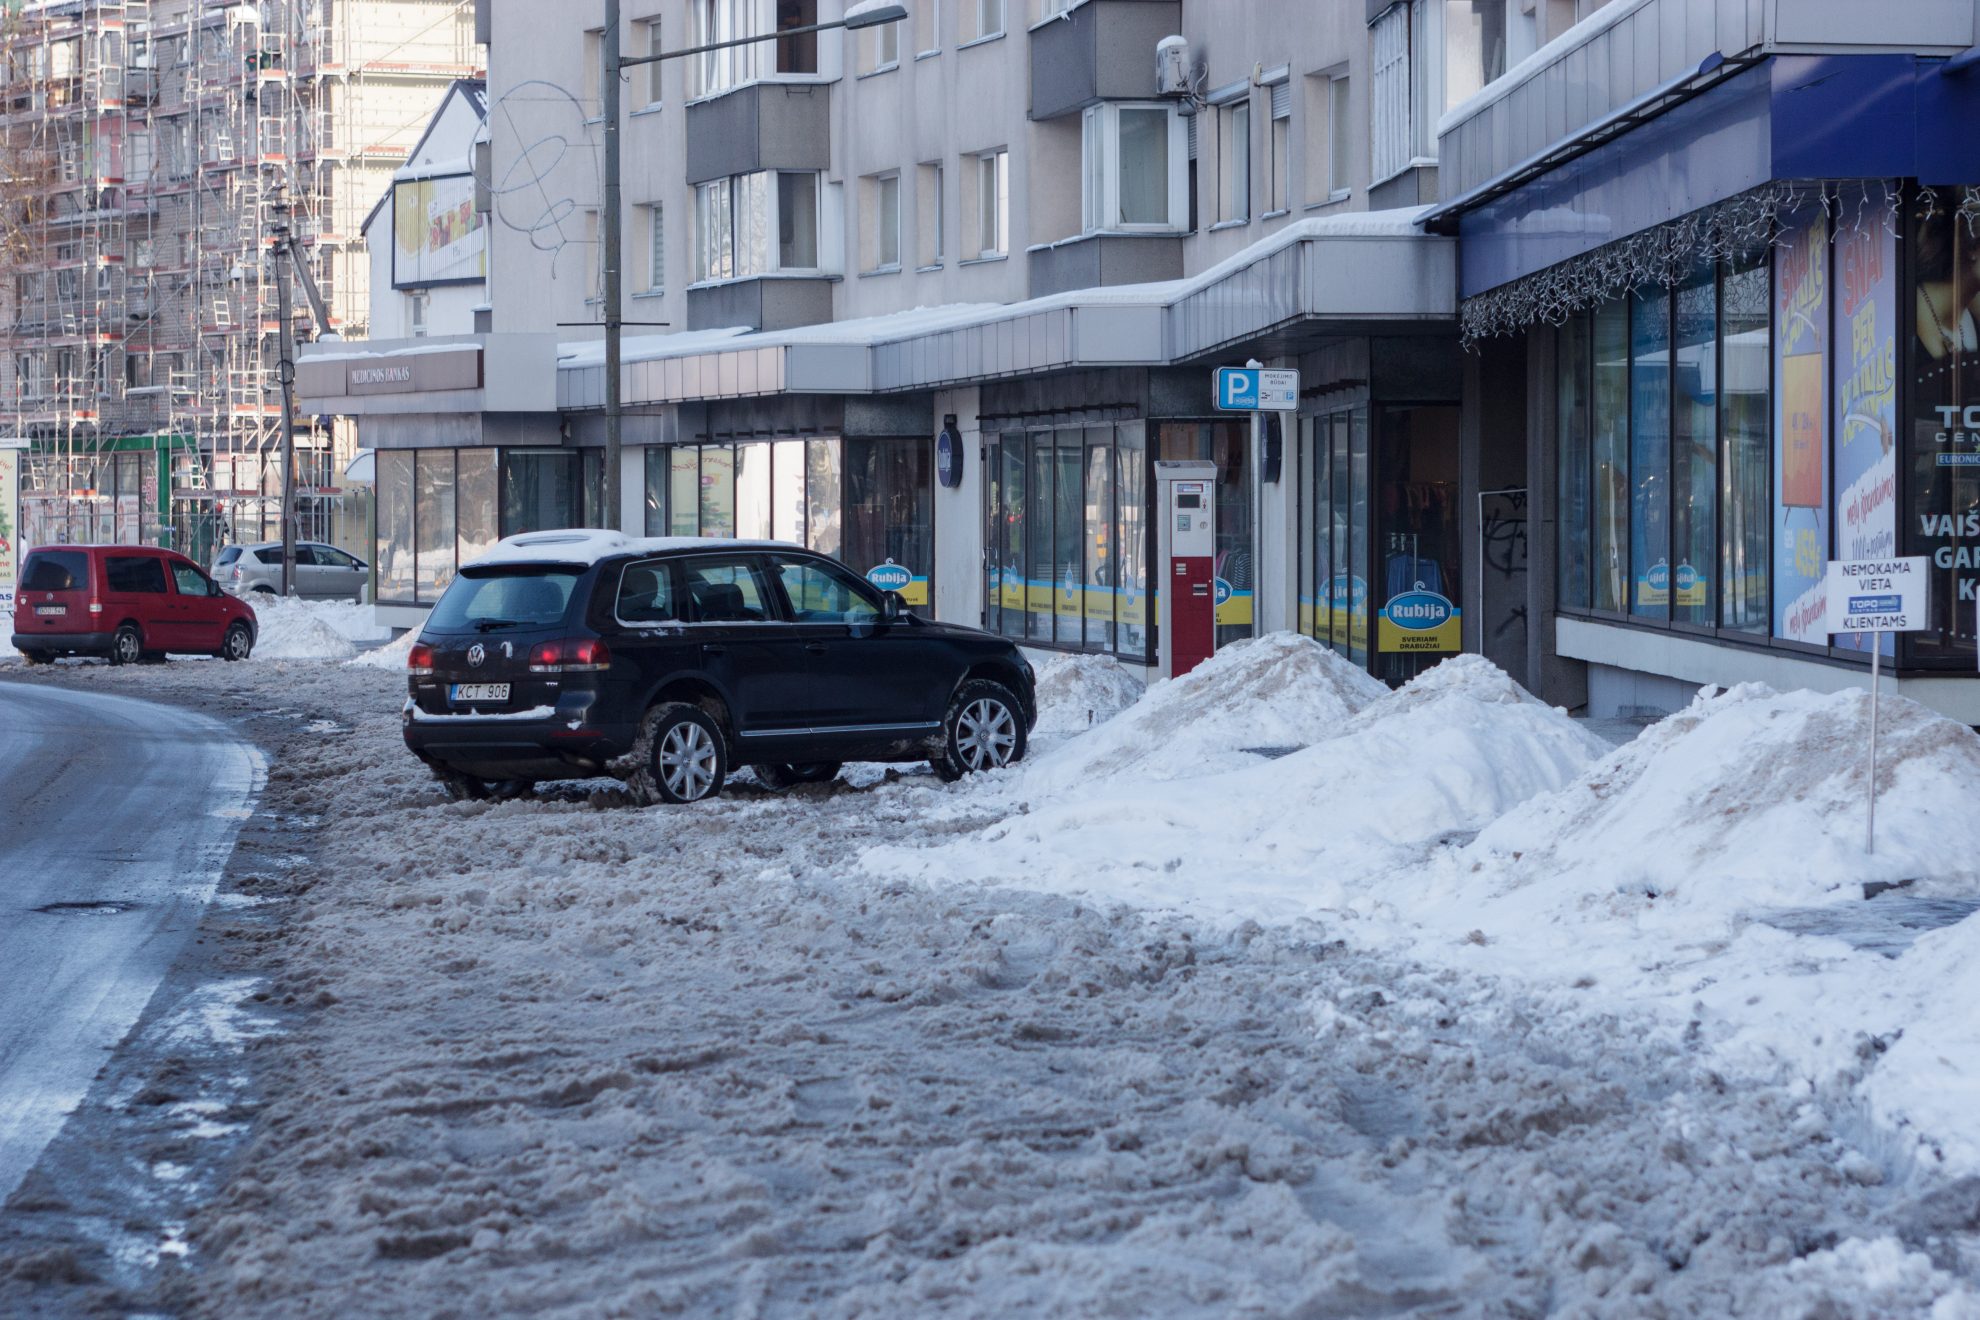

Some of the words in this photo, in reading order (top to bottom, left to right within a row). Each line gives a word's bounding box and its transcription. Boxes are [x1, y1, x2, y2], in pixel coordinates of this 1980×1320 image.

[352, 368, 385, 384] MEDICINOS
[385, 366, 410, 381] BANKAS
[1227, 373, 1250, 405] P
[1842, 562, 1911, 576] NEMOKAMA
[872, 572, 907, 585] Rubija
[1859, 579, 1892, 591] VIETA
[1393, 603, 1445, 619] Rubija
[1851, 599, 1878, 609] TOPO
[1843, 615, 1907, 629] KLIENTAMS
[458, 685, 479, 698] KCT
[487, 685, 508, 698] 906
